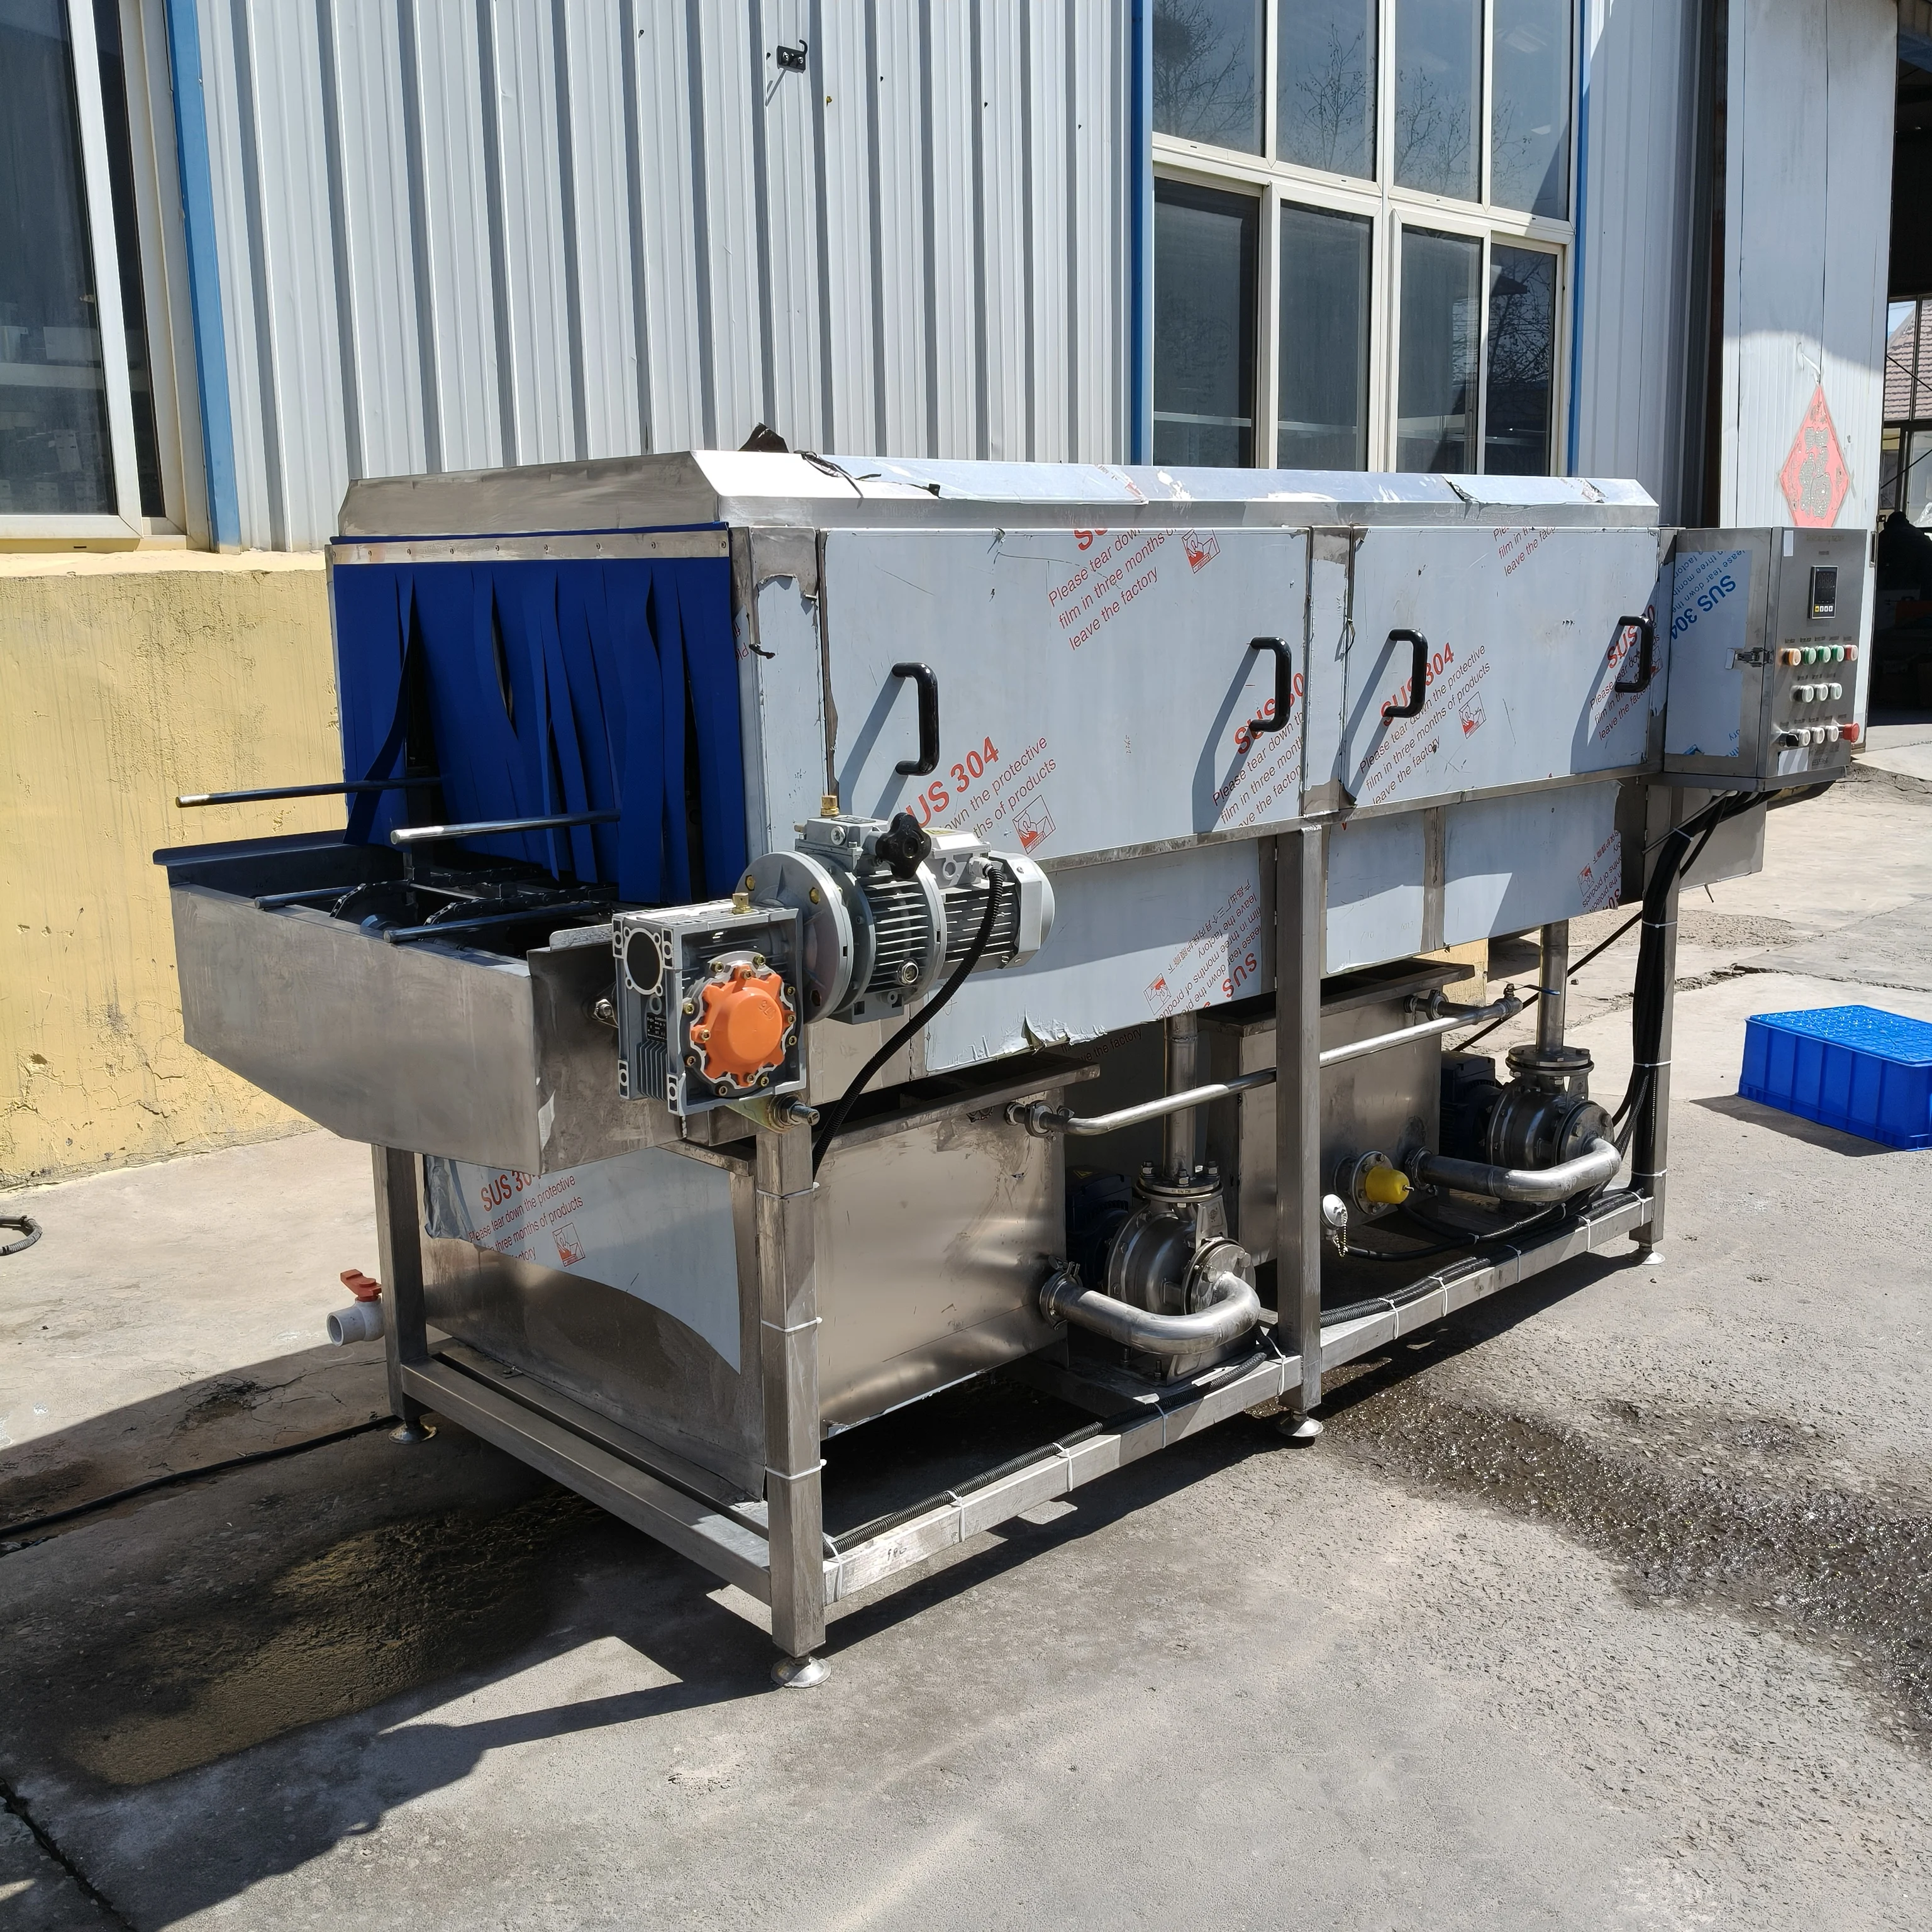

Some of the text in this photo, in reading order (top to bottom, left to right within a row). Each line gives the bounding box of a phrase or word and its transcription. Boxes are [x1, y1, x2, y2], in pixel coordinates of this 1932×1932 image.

[1499, 533, 1522, 560] film in
[1504, 552, 1526, 577] leave
[1526, 538, 1539, 555] the
[1696, 555, 1717, 574] three
[1048, 567, 1089, 608] Please
[1089, 547, 1113, 572] tear
[1058, 607, 1081, 630] film
[1081, 594, 1094, 611] in
[1094, 569, 1124, 599] three
[1124, 532, 1165, 573] months
[1684, 582, 1705, 601] down
[1697, 575, 1736, 612] SUS
[1706, 567, 1723, 583] tear
[1069, 566, 1158, 651] leave the factory
[1607, 625, 1638, 669] SUS
[1359, 741, 1390, 774] Please
[1391, 721, 1408, 744] tear
[1433, 684, 1446, 702] the
[1447, 644, 1485, 689] protective
[1589, 681, 1614, 711] Please
[1594, 707, 1607, 726] film
[1608, 699, 1616, 711] in
[1365, 662, 1491, 792] film in three months of products
[1598, 717, 1619, 741] leave
[1618, 704, 1630, 720] the
[950, 736, 1000, 793] 304
[970, 790, 991, 811] the
[992, 736, 1048, 796] protective
[1213, 769, 1247, 807] Please
[1247, 748, 1267, 770] tear
[1268, 723, 1294, 752] down
[1372, 735, 1440, 805] leave the factory
[994, 801, 1006, 820] of
[1008, 758, 1057, 811] products
[1221, 802, 1240, 826] film
[1240, 791, 1251, 806] in
[1250, 765, 1276, 796] three
[1256, 794, 1273, 813] the
[1582, 877, 1603, 908] products
[1602, 872, 1609, 884] of
[1198, 892, 1257, 958] leave the factory
[1220, 930, 1240, 953] three
[1239, 921, 1249, 932] in
[1193, 951, 1219, 984] months
[1222, 953, 1257, 998] SUS
[1227, 947, 1241, 967] tear
[1185, 982, 1193, 996] of
[1194, 986, 1208, 1002] the
[1207, 964, 1226, 988] down
[1093, 1044, 1109, 1057] the
[1109, 1027, 1142, 1050] factory
[469, 1175, 576, 1243] Please tear down the protective
[480, 1174, 513, 1212] SUS
[495, 1196, 584, 1252] three months of products
